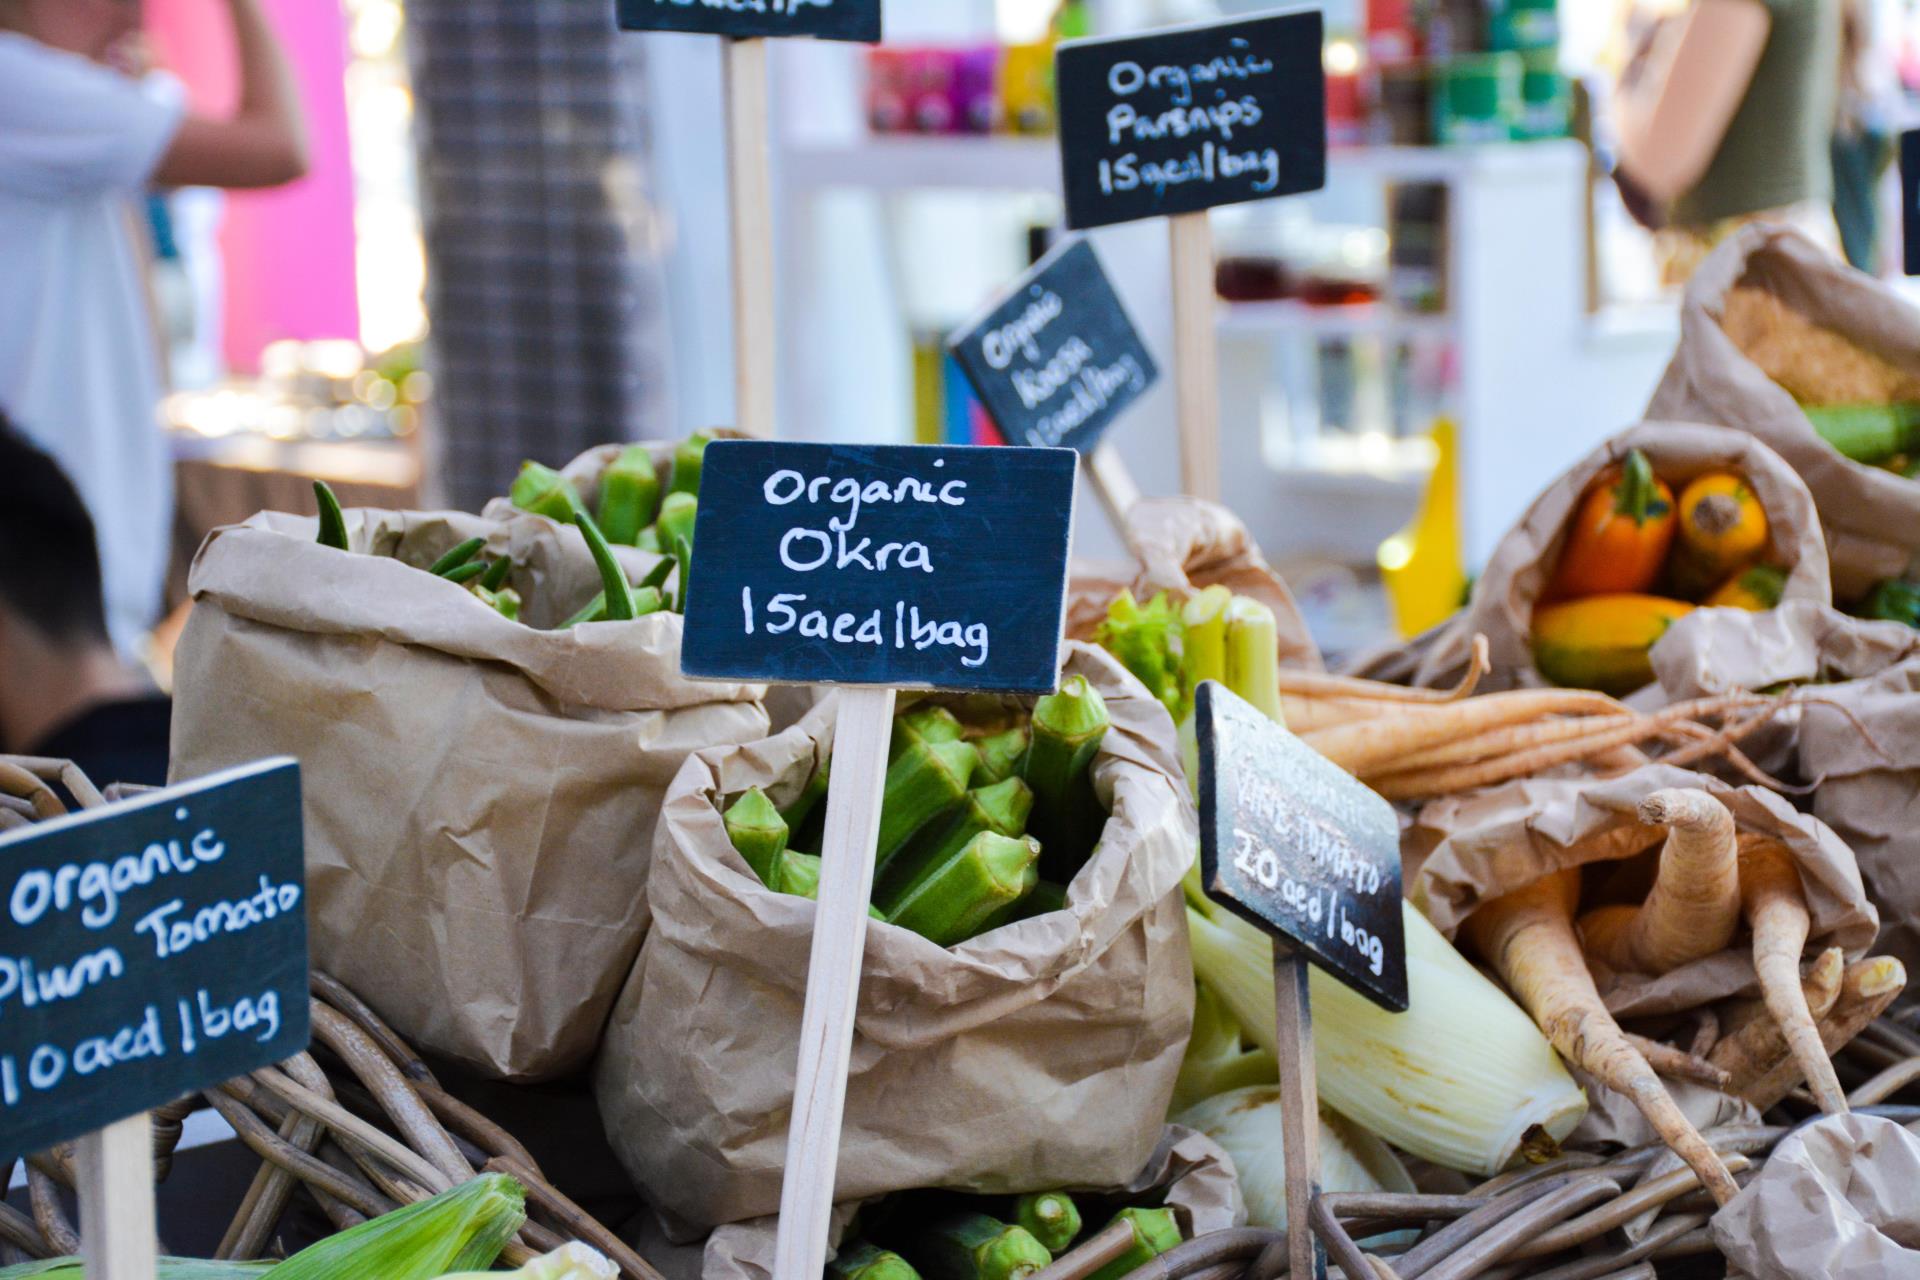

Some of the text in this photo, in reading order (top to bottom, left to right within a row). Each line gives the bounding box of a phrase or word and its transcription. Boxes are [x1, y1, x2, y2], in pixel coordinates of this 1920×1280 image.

[1107, 37, 1274, 106] Organic
[1106, 88, 1263, 144] Parsnips
[763, 458, 968, 532] Organic
[779, 527, 934, 573] Okra
[9, 806, 225, 929] Organic
[133, 874, 301, 958] Tomato
